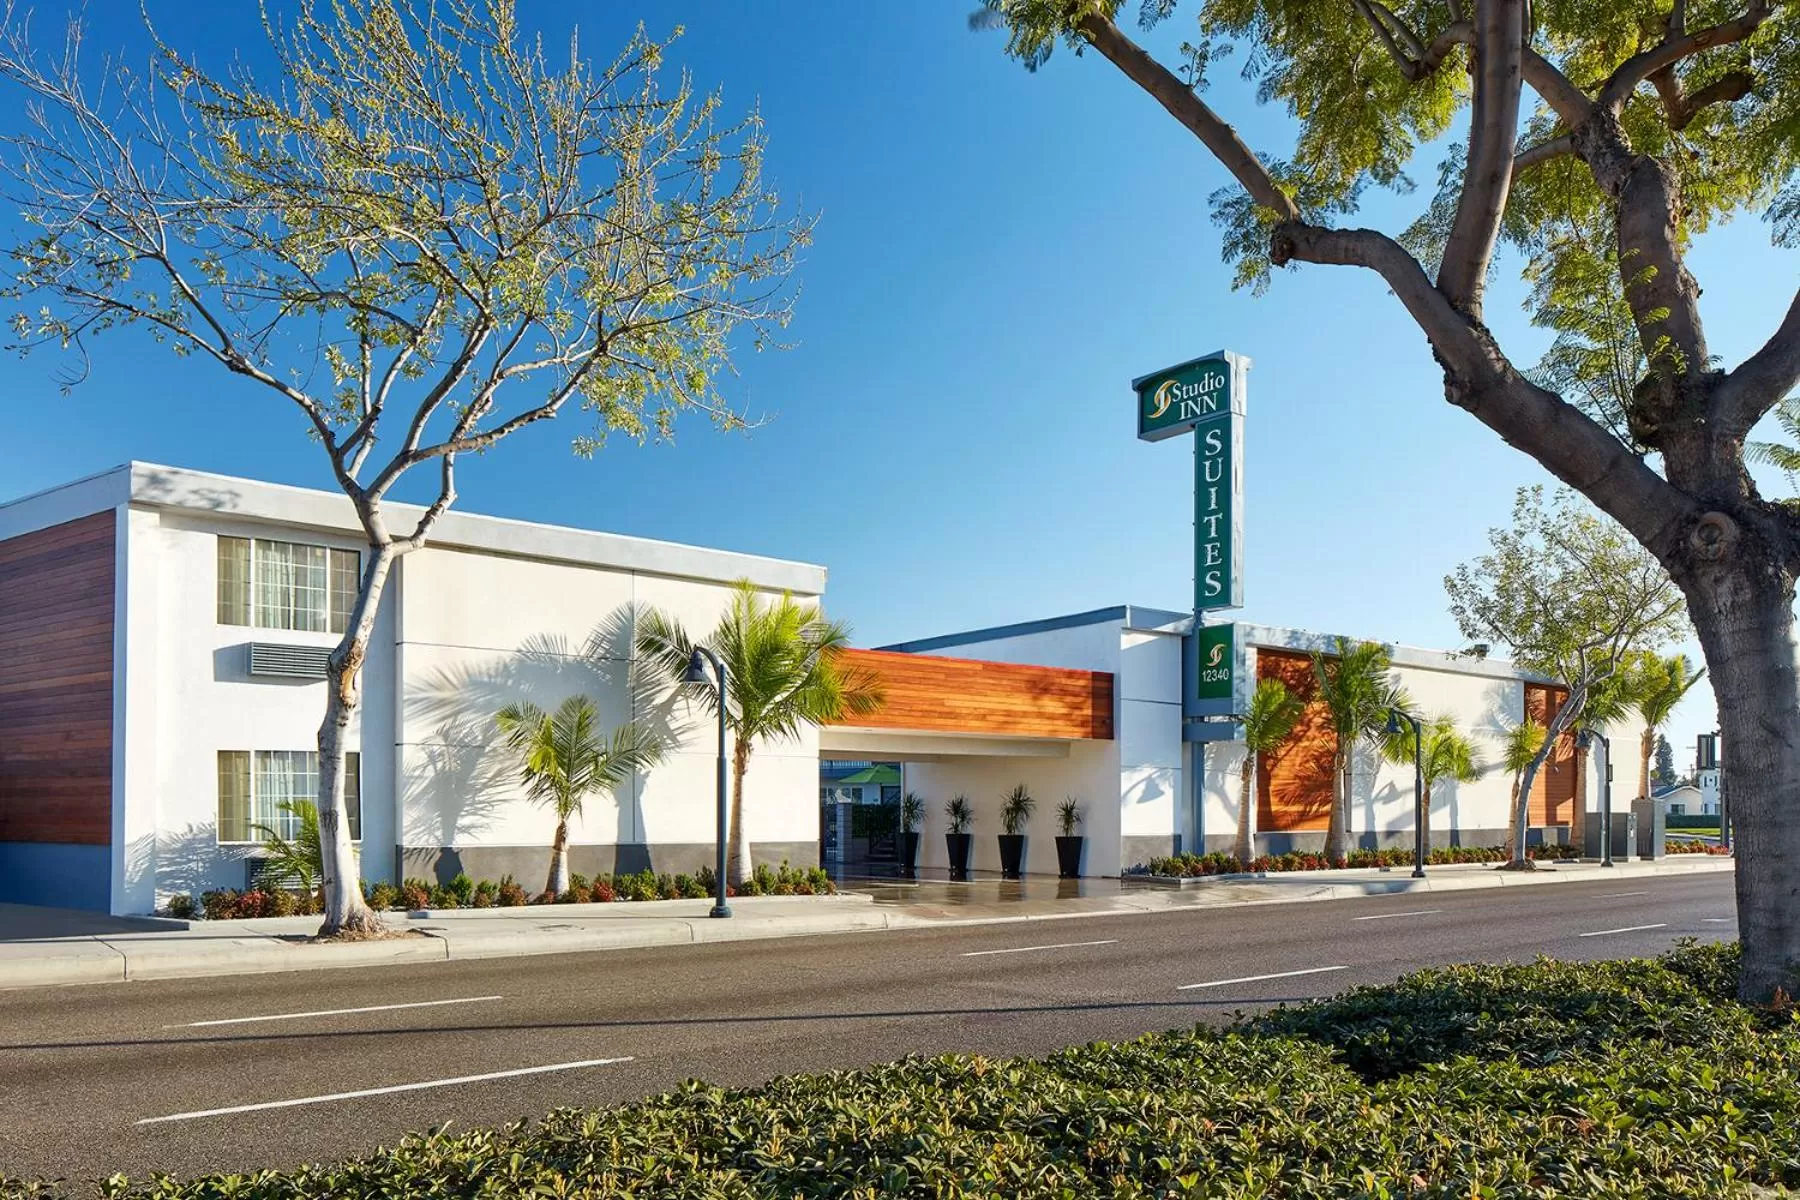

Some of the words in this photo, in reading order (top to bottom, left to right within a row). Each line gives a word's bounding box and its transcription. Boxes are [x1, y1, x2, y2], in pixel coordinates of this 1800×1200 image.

[1172, 371, 1225, 402] Studio
[1179, 392, 1218, 420] INN
[1203, 428, 1224, 597] SUITES
[1202, 668, 1230, 682] 12340
